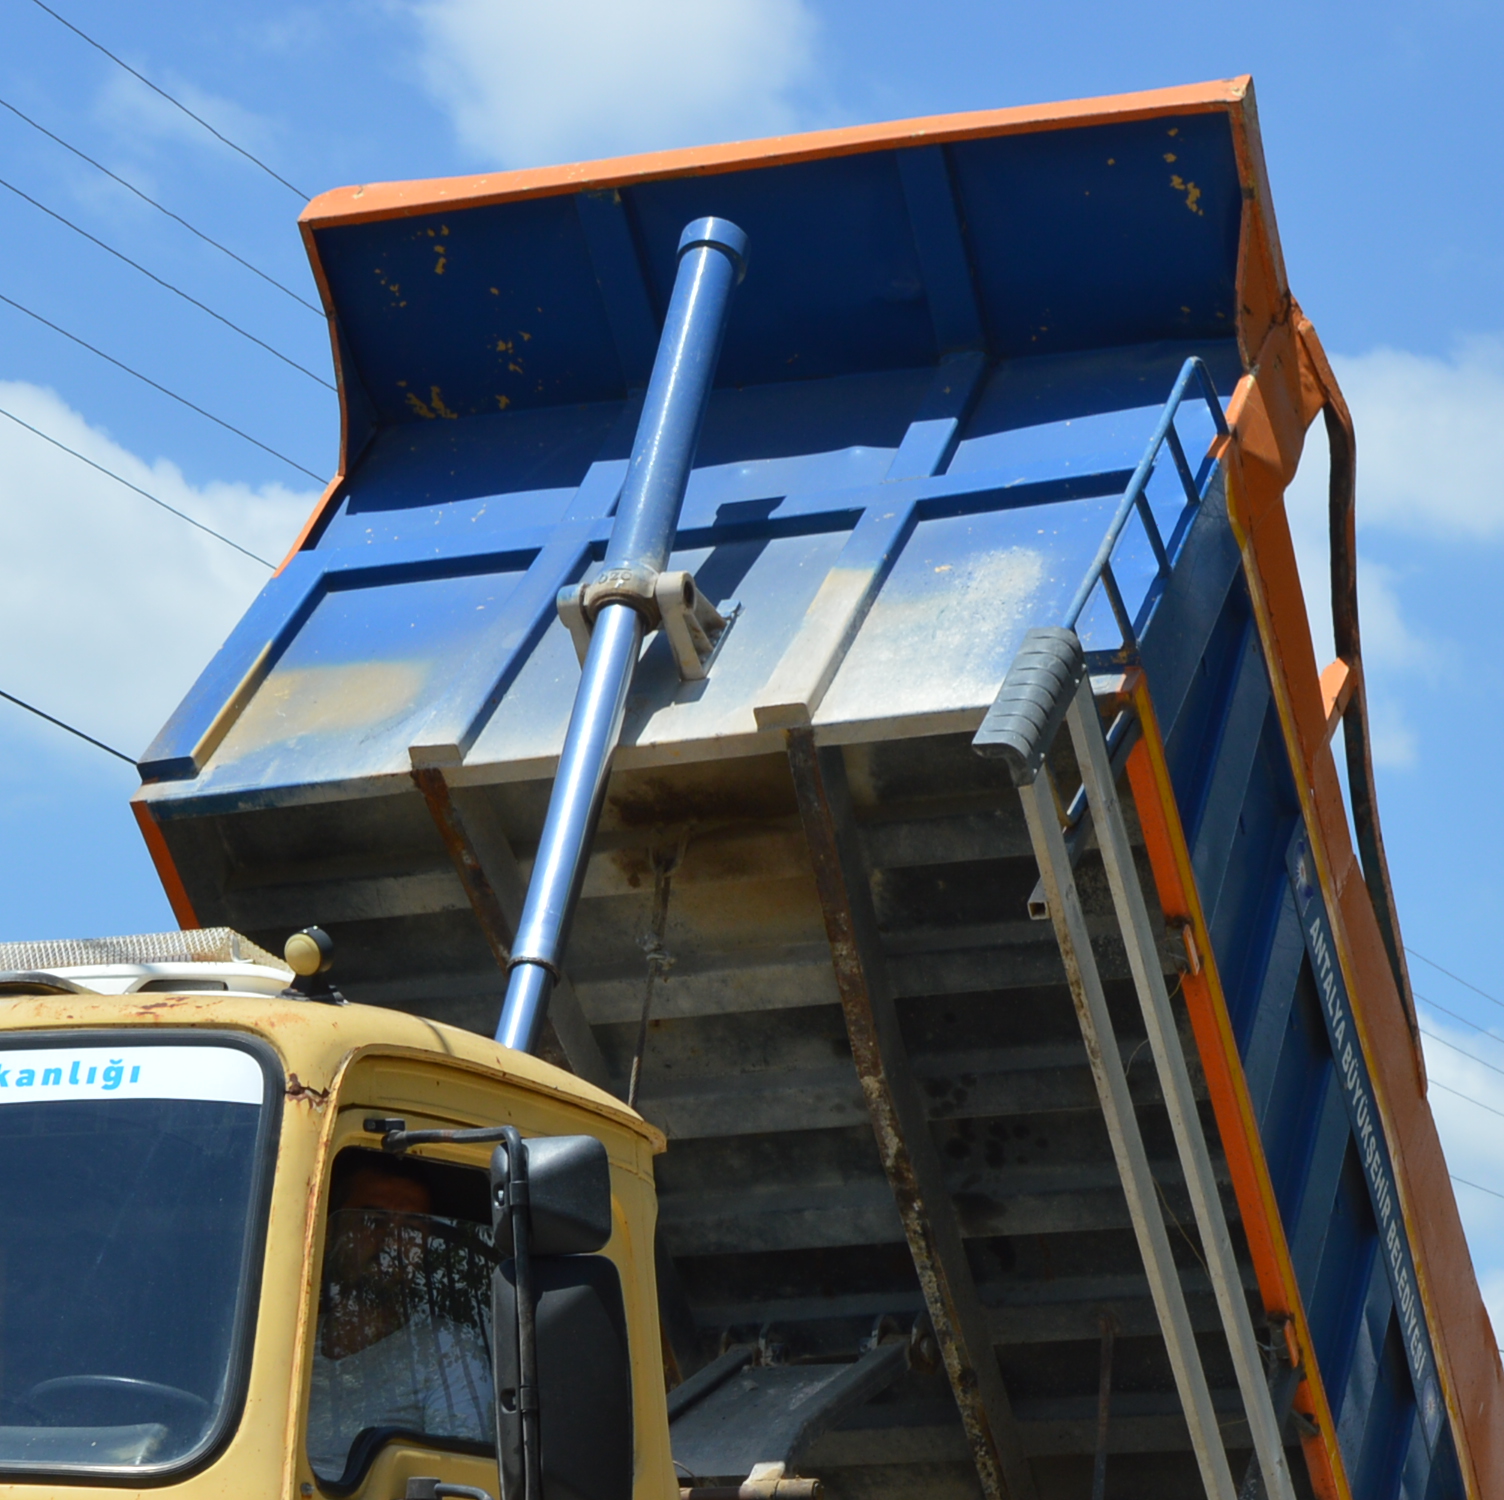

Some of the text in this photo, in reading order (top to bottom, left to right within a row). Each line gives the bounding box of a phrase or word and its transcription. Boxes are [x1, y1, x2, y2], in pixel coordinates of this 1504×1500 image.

[1309, 917, 1427, 1380] ANTALYA BÜYÜKŞEHİR BELEDİYESİ
